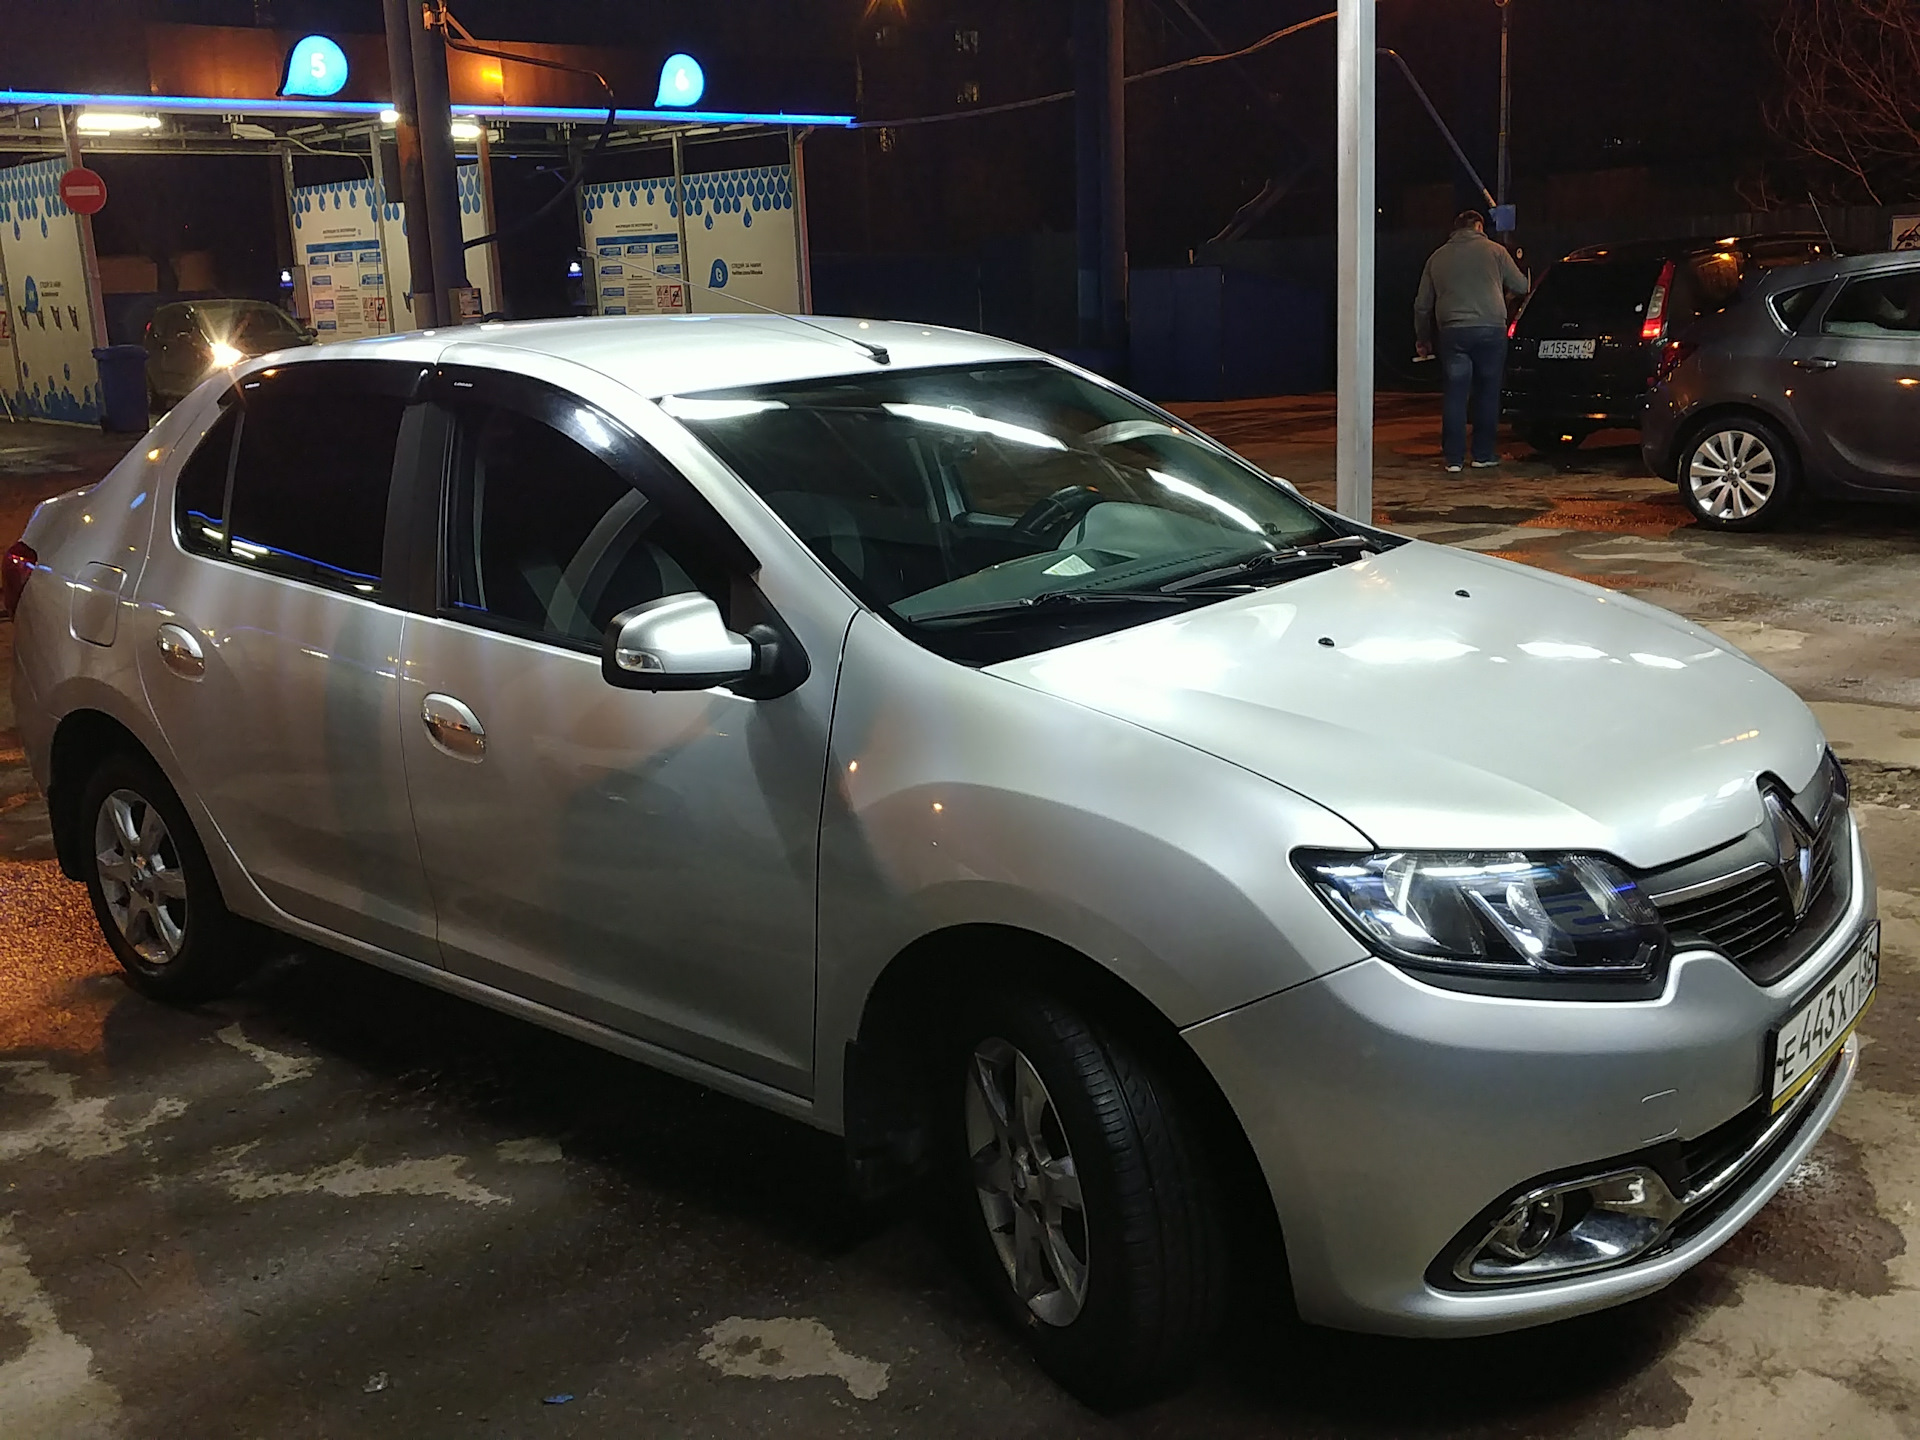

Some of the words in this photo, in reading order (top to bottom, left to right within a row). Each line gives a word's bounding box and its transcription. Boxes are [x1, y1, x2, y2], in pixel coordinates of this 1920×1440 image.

[311, 52, 326, 78] 5
[675, 68, 689, 91] 6
[1582, 341, 1593, 351] 40
